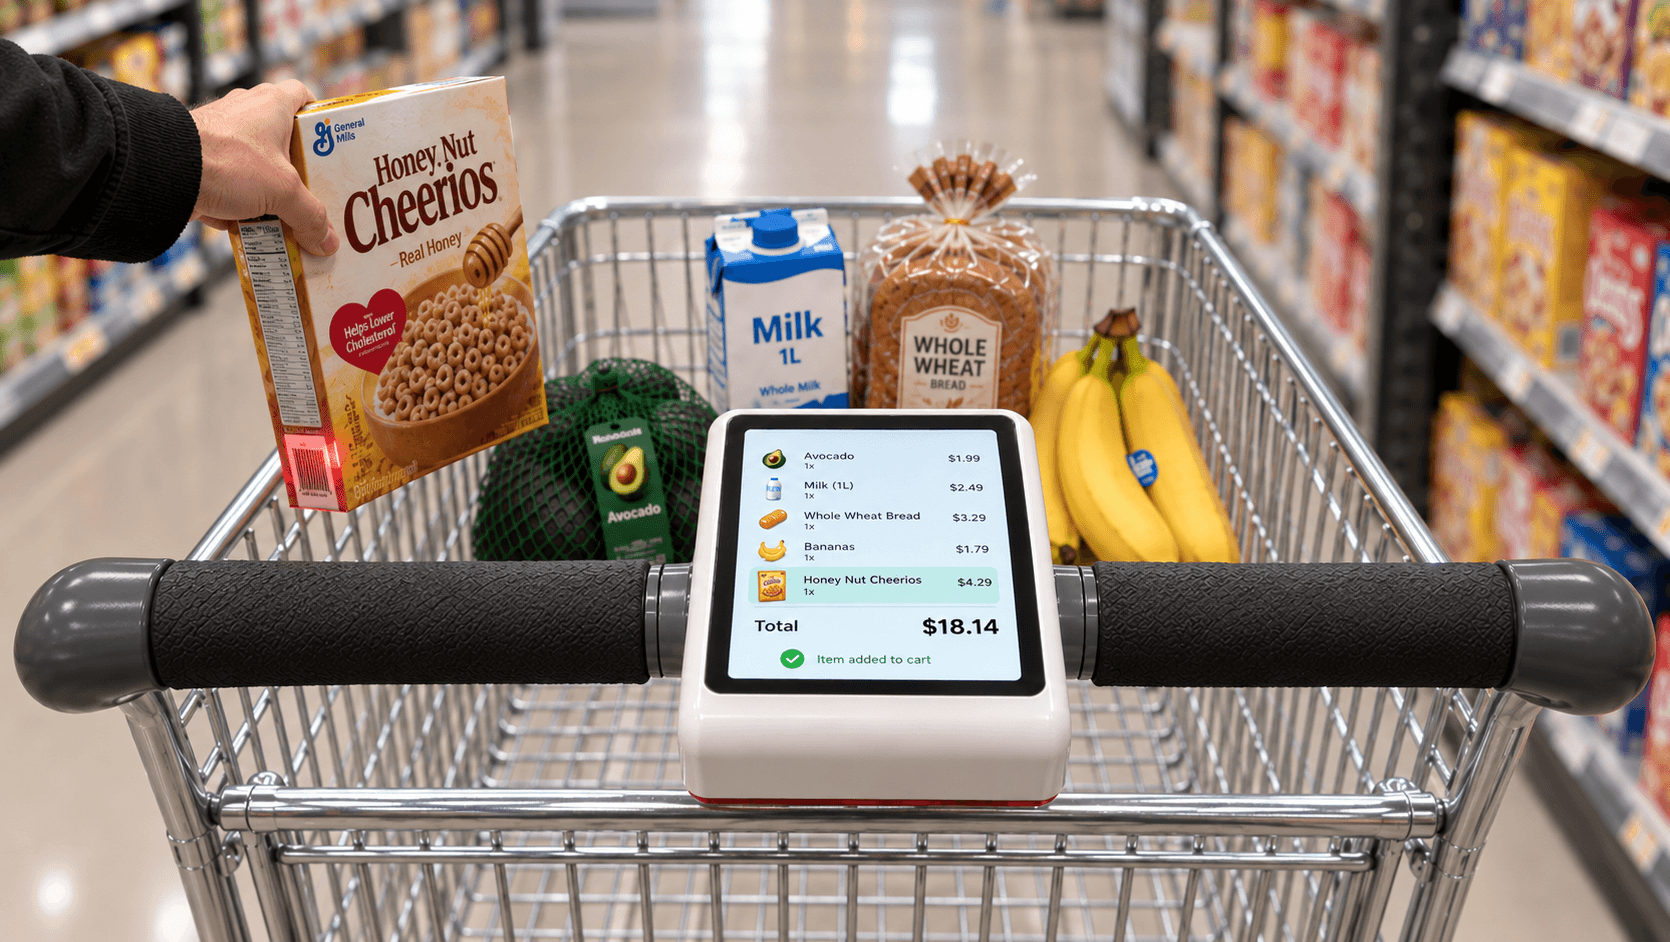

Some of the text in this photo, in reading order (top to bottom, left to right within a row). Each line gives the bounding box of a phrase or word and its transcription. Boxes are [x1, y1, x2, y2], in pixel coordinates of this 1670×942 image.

[334, 117, 365, 132] General
[440, 130, 478, 163] Nut
[344, 161, 498, 254] Cheerios
[399, 231, 462, 268] Real Honey
[343, 311, 395, 340] Helps Lower
[752, 310, 824, 344] Milk
[913, 335, 988, 357] WHOLE
[779, 347, 802, 365] 1L
[914, 356, 986, 377] WHEAT
[759, 380, 821, 397] Whole Milk
[930, 378, 967, 391] BREAD
[803, 451, 981, 463] Avocado $1.99
[804, 462, 815, 470] 1x
[804, 480, 984, 492] Milk (1L) $2.49
[804, 492, 815, 500] 1x
[607, 503, 662, 524] Avocado
[803, 511, 987, 523] Whole Wheat Bread $3.29
[804, 523, 815, 531] 1x
[804, 542, 990, 554] Bananas $1.79
[804, 553, 815, 561] 1x
[803, 574, 993, 588] Honey Nut Cheerios $4.29
[803, 587, 815, 596] 1x
[754, 616, 1000, 637] Total $18.14
[816, 654, 932, 665] Item added to cart
